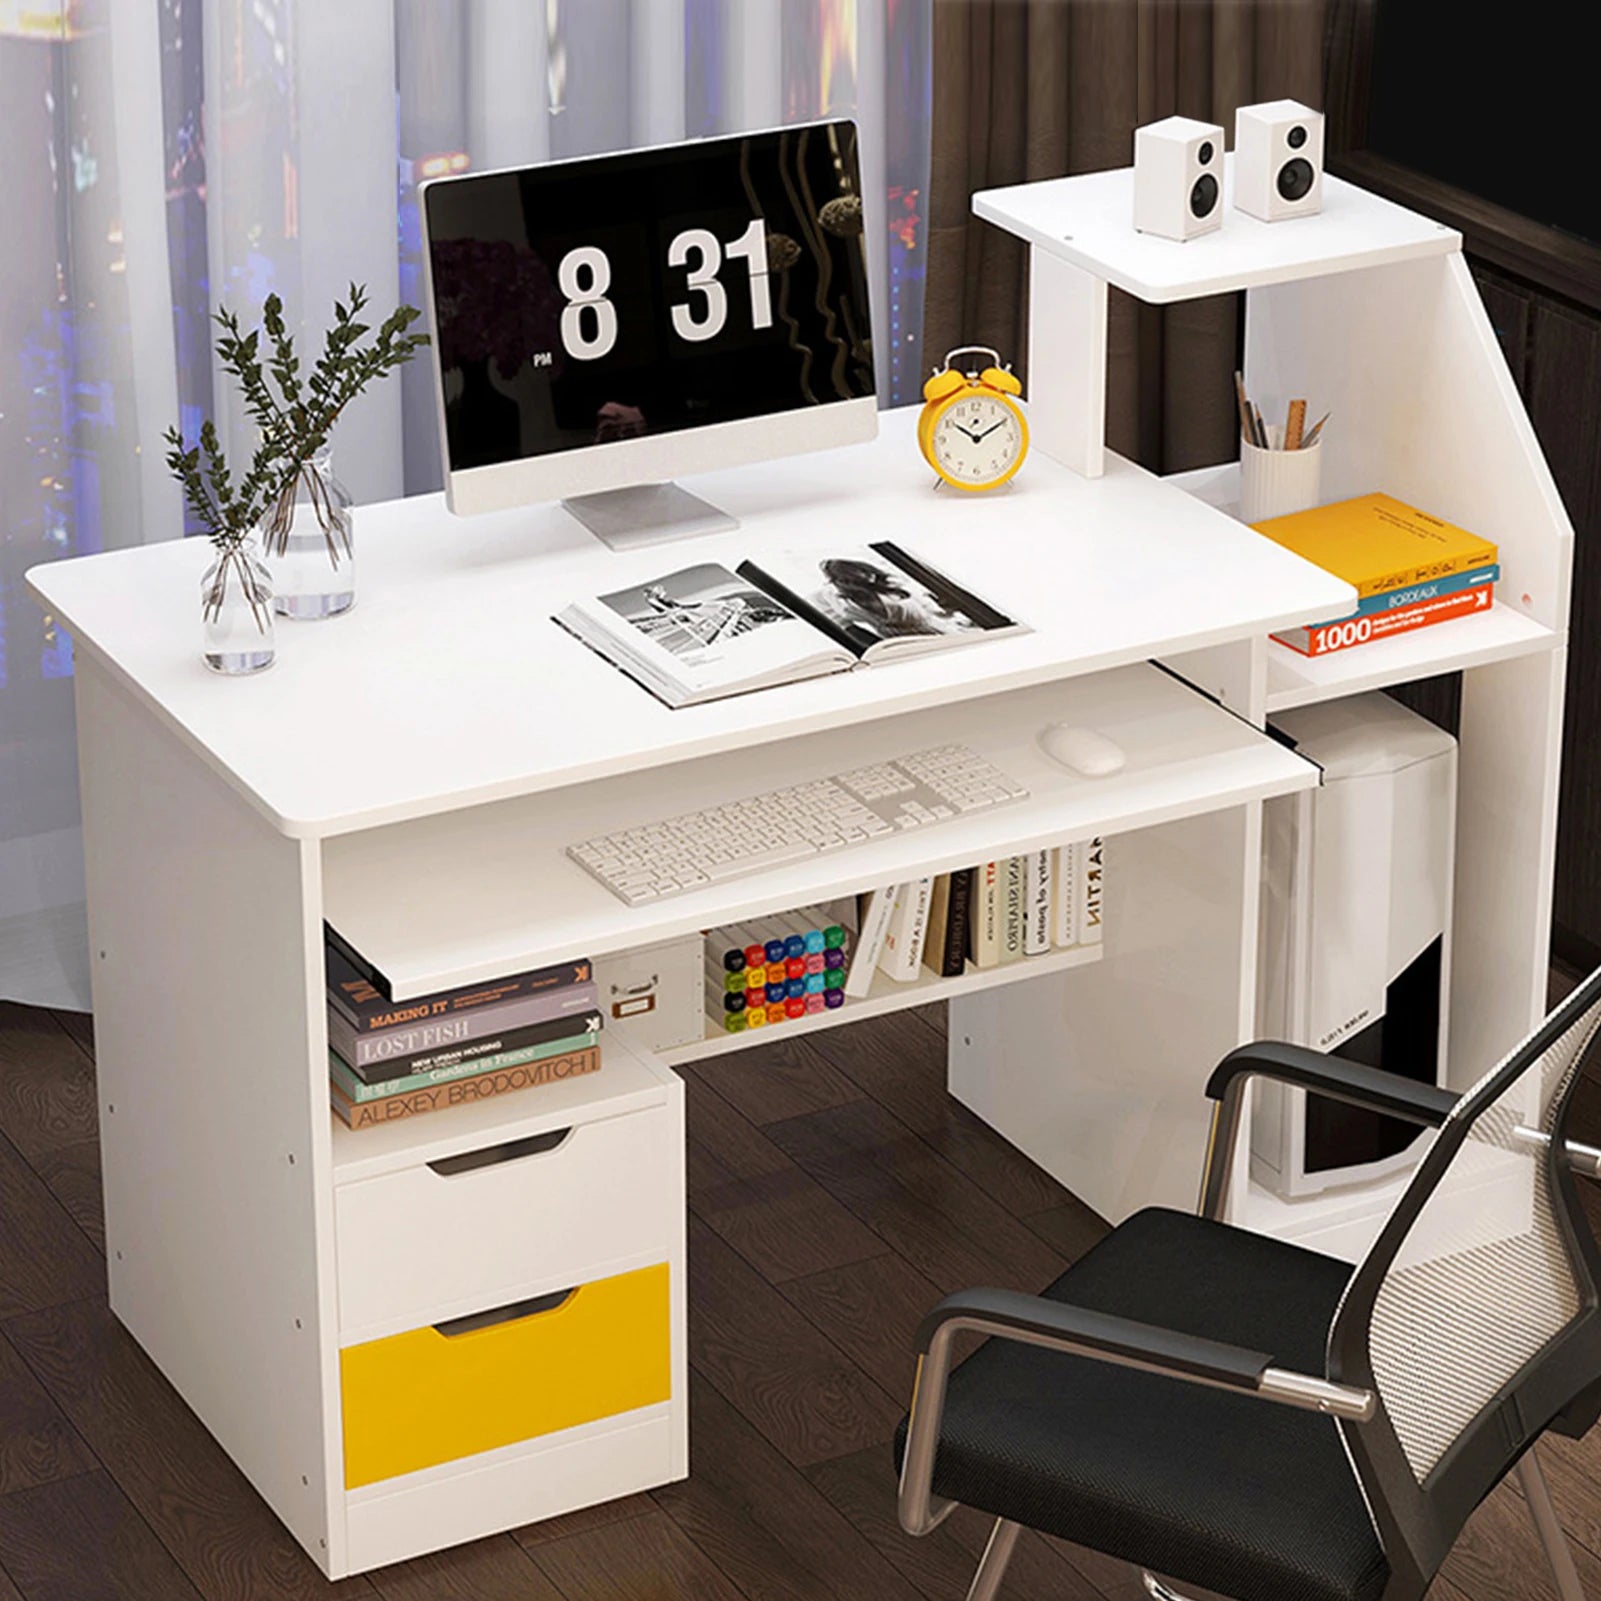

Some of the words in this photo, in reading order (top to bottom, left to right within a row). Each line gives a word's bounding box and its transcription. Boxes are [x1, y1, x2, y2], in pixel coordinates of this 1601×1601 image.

[558, 246, 618, 361] 8
[667, 218, 774, 342] 31
[533, 351, 552, 367] PM
[1315, 618, 1372, 653] 1000
[369, 1005, 429, 1029] MAKING
[432, 1000, 448, 1014] IT
[364, 1032, 418, 1060] LOST
[423, 1020, 468, 1047] FISH
[358, 1090, 442, 1127] ALEXEY
[448, 1055, 586, 1104] BRODOVITCH
